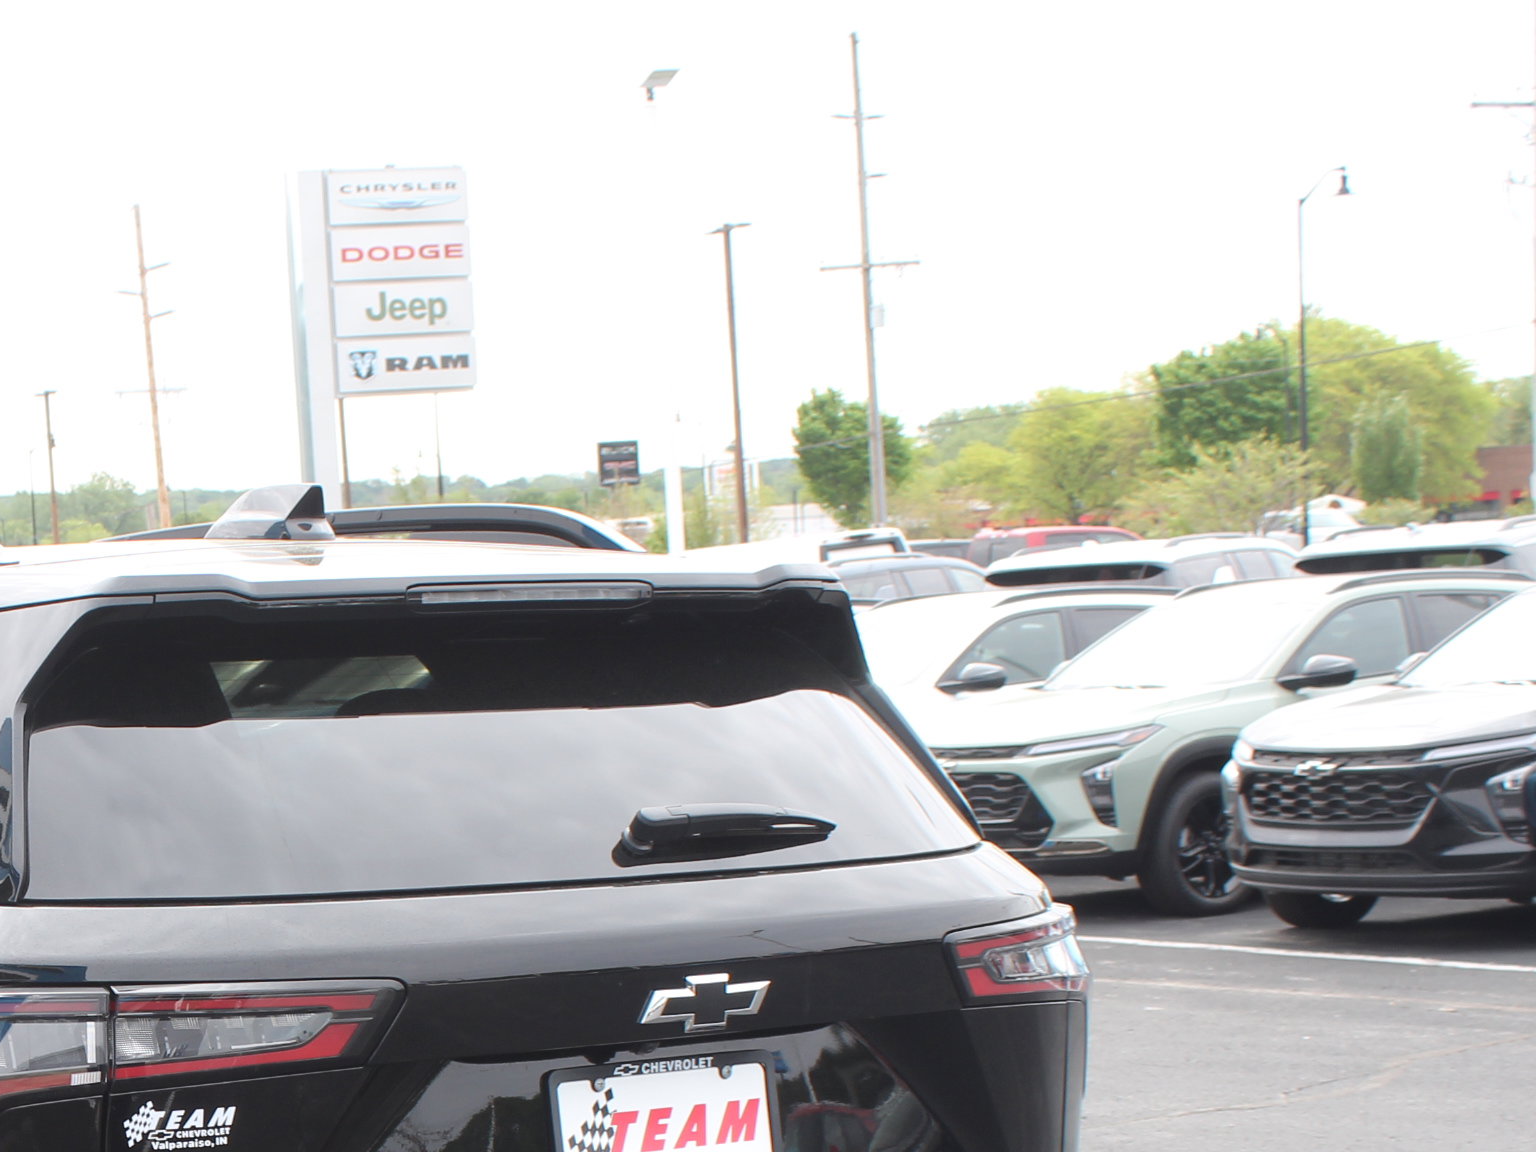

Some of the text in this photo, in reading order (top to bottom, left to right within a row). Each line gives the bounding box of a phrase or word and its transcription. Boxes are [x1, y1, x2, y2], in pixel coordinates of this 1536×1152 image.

[339, 181, 457, 194] CHRYSLER
[341, 243, 464, 263] DODGE
[366, 291, 447, 325] Jeep
[385, 354, 470, 372] RAM
[641, 1056, 713, 1075] CHEVROLET
[148, 1106, 237, 1131] TEAM
[175, 1127, 231, 1139] CHEVROLET
[151, 1136, 228, 1151] Valparaiso, IN
